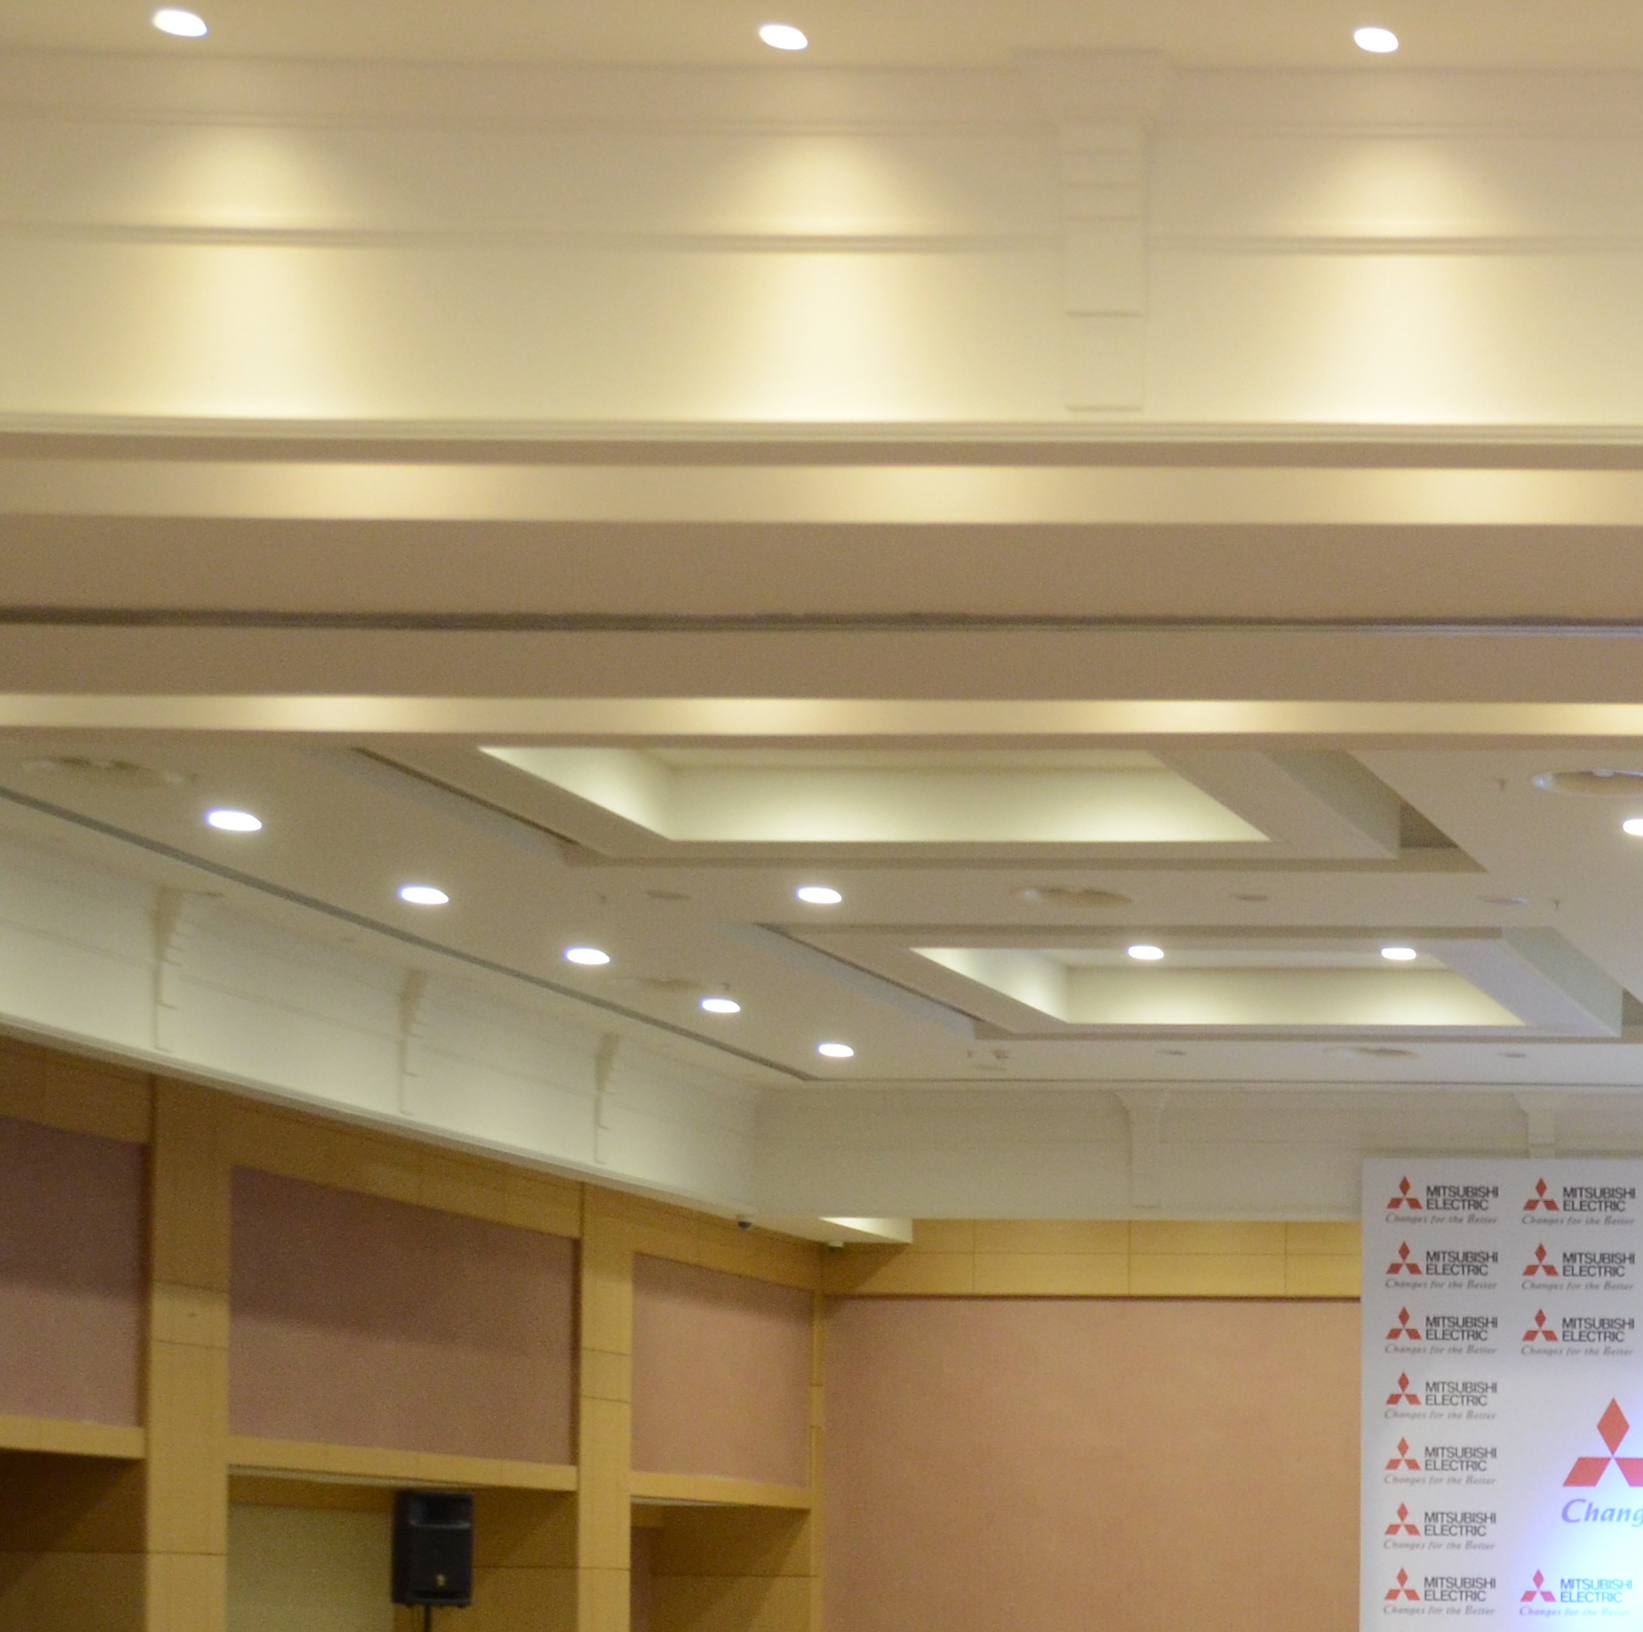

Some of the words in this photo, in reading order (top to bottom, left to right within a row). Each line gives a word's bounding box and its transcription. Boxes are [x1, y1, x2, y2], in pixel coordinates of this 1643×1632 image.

[1426, 1184, 1499, 1198] MITSUBISHI
[1562, 1186, 1635, 1200] MITSUBISHI
[1426, 1198, 1490, 1211] ELECTRIC
[1562, 1200, 1626, 1213] ELECTRIC
[1425, 1250, 1498, 1264] MITSUBISHI
[1562, 1251, 1635, 1265] MITSUBISHI
[1425, 1264, 1489, 1277] ELECTRIC
[1562, 1265, 1626, 1278] ELECTRIC
[1425, 1315, 1498, 1329] MITSUBISHI
[1425, 1329, 1489, 1342] ELECTRIC
[1425, 1380, 1498, 1394] MITSUBISHI
[1425, 1394, 1489, 1407] ELECTRIC
[1424, 1445, 1497, 1459] MITSUBISHI
[1424, 1459, 1488, 1472] ELECTRIC
[1424, 1510, 1497, 1524] MITSUBISHI
[1424, 1524, 1488, 1537] ELECTRIC
[1423, 1575, 1496, 1589] MITSUBISHI
[1423, 1589, 1487, 1602] ELECTRIC
